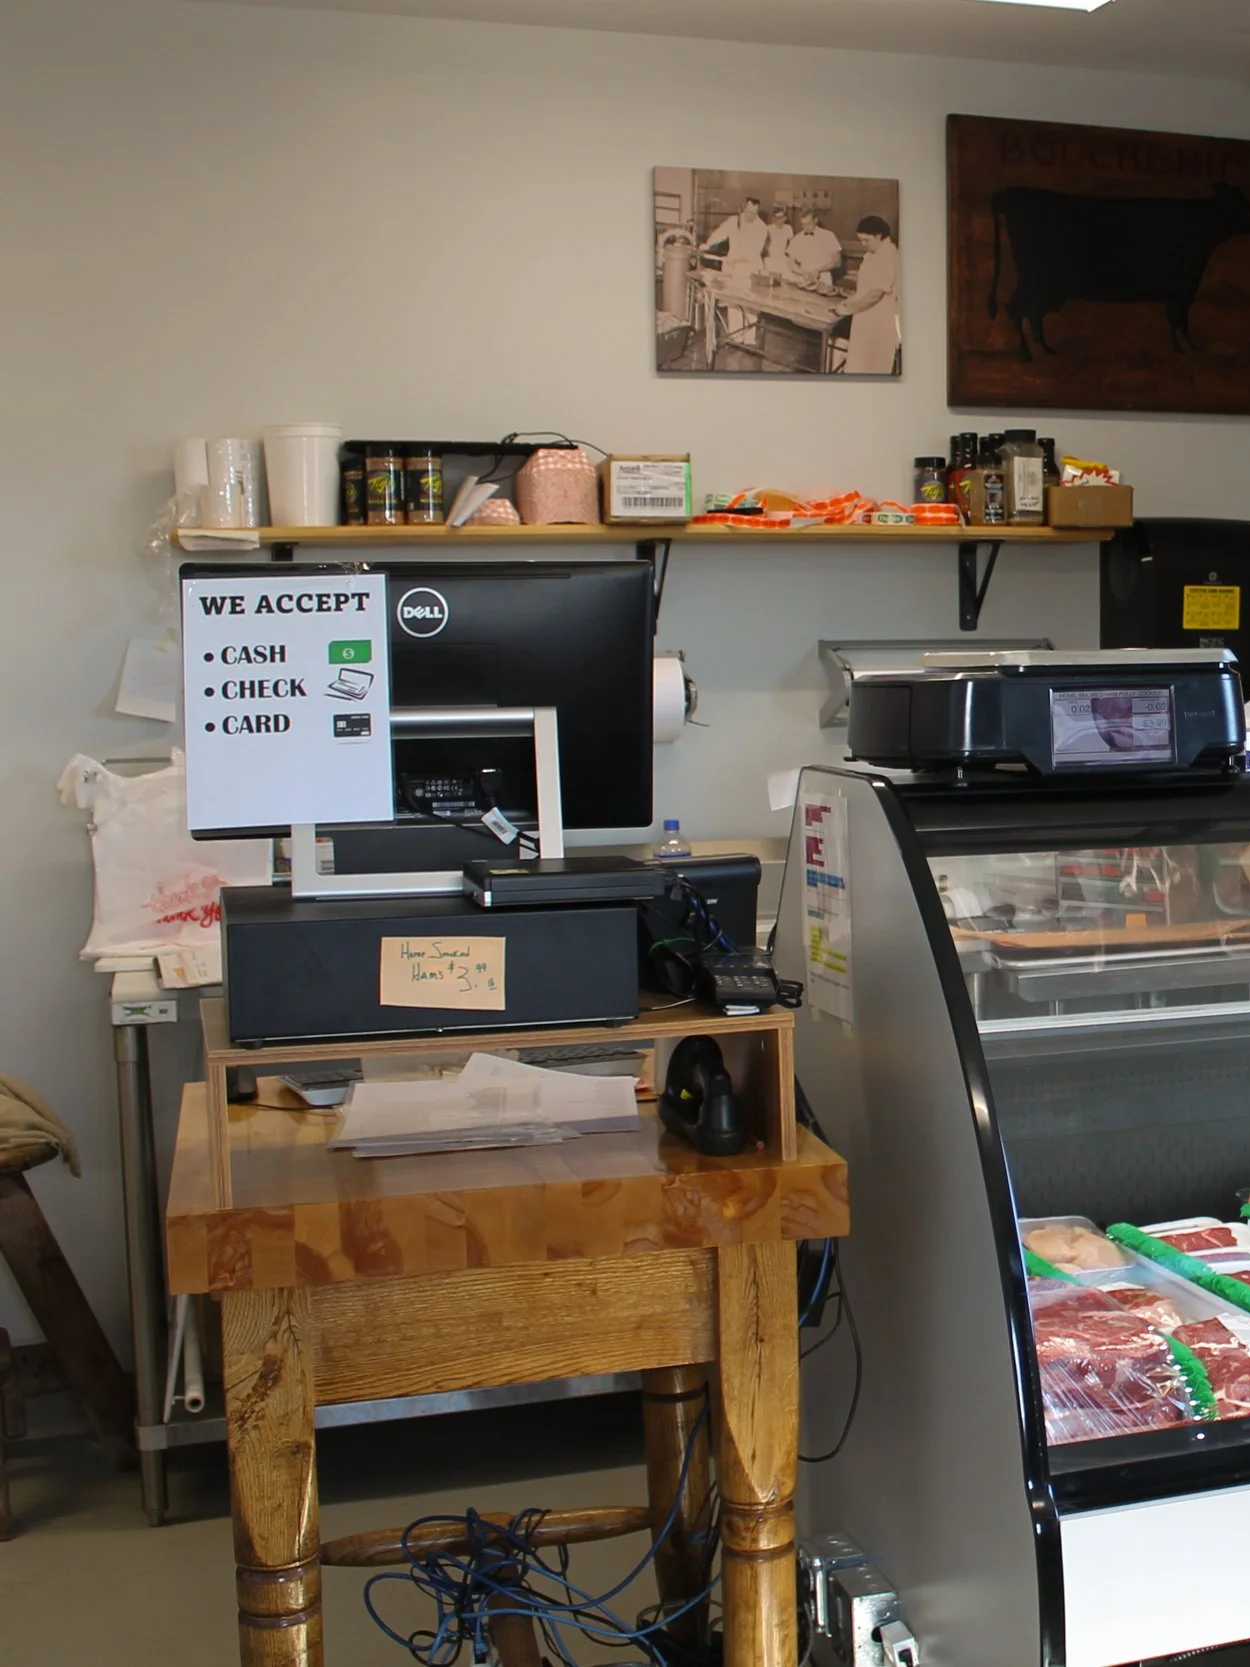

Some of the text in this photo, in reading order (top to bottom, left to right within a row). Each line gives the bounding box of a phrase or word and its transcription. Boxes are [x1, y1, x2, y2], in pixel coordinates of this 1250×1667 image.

[200, 593, 370, 615] WE ACCEPT
[403, 605, 442, 618] DELL
[221, 645, 286, 665] CASH
[221, 679, 307, 699] CHECK
[1071, 704, 1090, 713] 0.02
[222, 714, 290, 734] CARD
